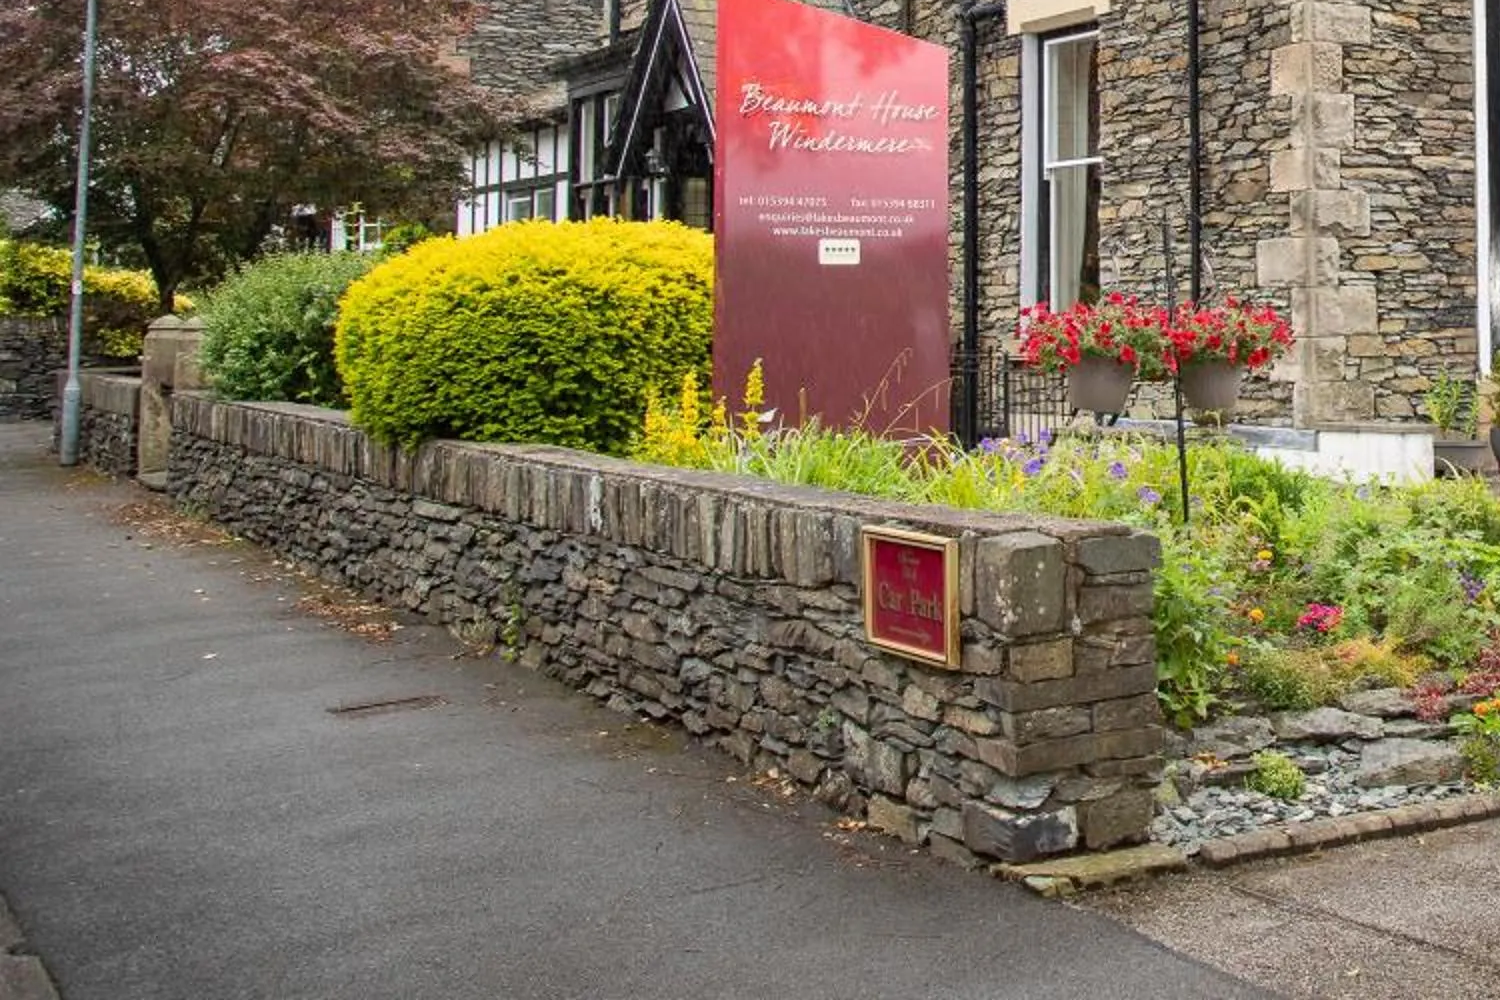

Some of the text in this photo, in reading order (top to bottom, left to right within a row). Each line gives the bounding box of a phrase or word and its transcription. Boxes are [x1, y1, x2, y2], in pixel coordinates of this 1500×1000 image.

[739, 82, 939, 123] Beaumont House
[768, 121, 932, 153] Windermere
[878, 582, 943, 622] Car Park
